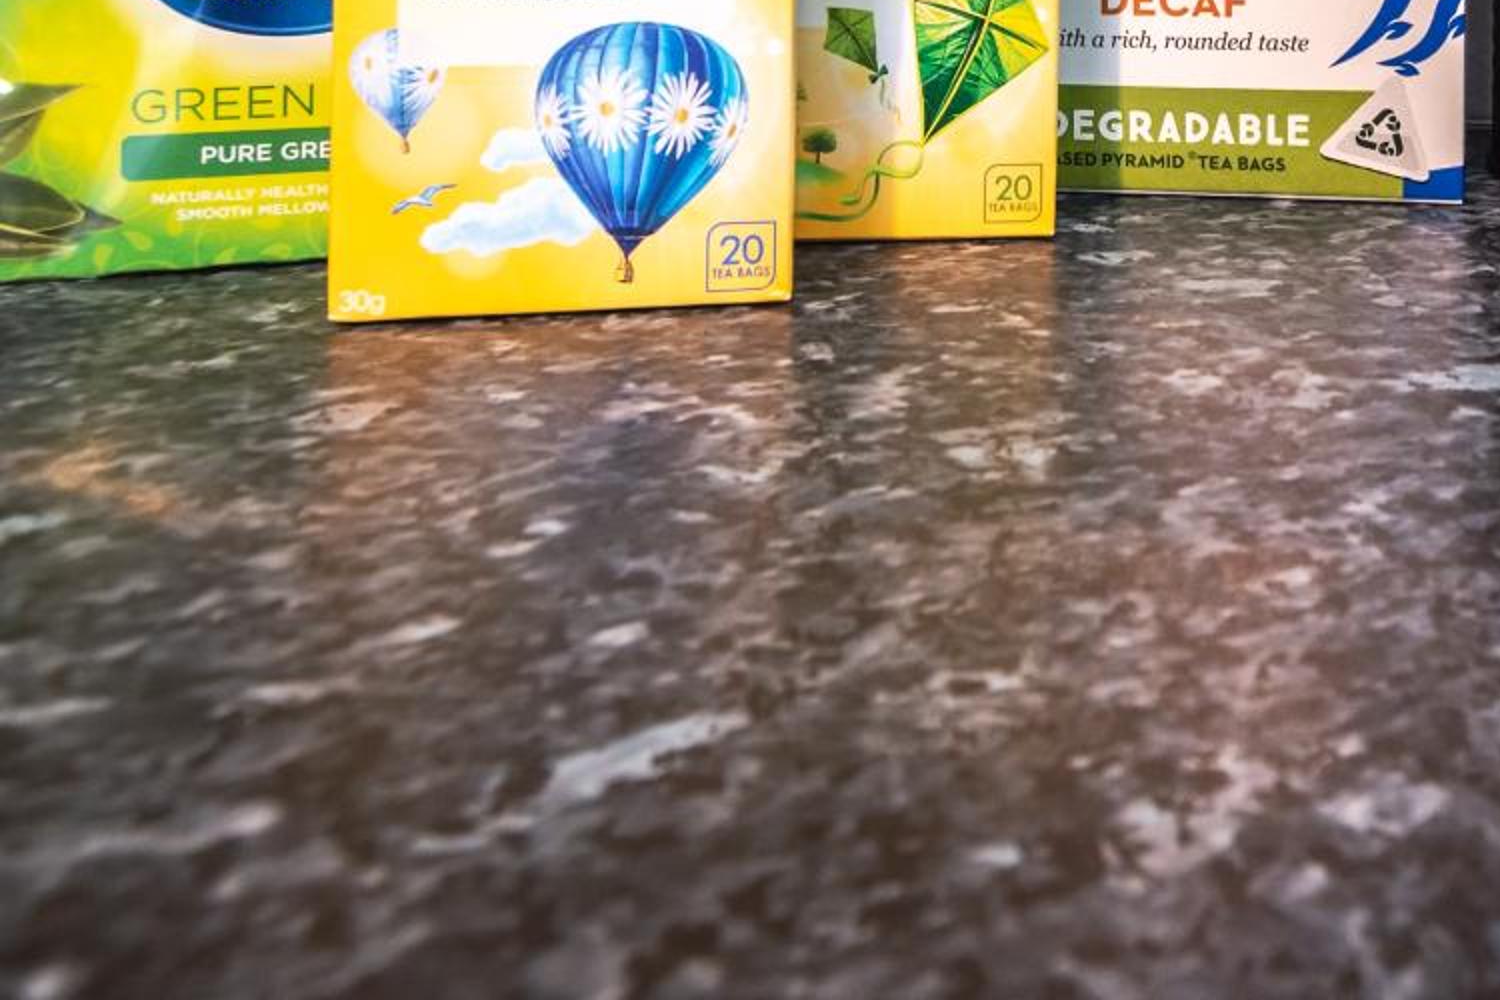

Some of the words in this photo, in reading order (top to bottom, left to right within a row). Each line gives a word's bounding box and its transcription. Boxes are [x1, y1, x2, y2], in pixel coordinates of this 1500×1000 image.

[1058, 28, 1085, 48] ith
[1091, 34, 1105, 48] a
[1110, 30, 1157, 52] rich,
[1164, 31, 1252, 51] rounded
[1258, 35, 1309, 53] taste
[131, 83, 316, 124] GREEN
[1057, 108, 1311, 147] DEGRADABLE
[200, 144, 272, 165] PURE
[281, 140, 331, 161] GRE
[1057, 152, 1097, 167] SED
[1101, 152, 1185, 168] PYRAMID
[1198, 155, 1232, 170] TEA
[1237, 157, 1286, 172] BAGS
[151, 187, 256, 205] NATURALLY
[260, 183, 329, 200] HEALTH
[995, 174, 1033, 201] 20
[176, 204, 253, 221] SMOOTH
[720, 234, 765, 265] 20
[713, 267, 733, 279] TEA
[738, 266, 771, 278] BAGS
[337, 287, 386, 316] 30g
